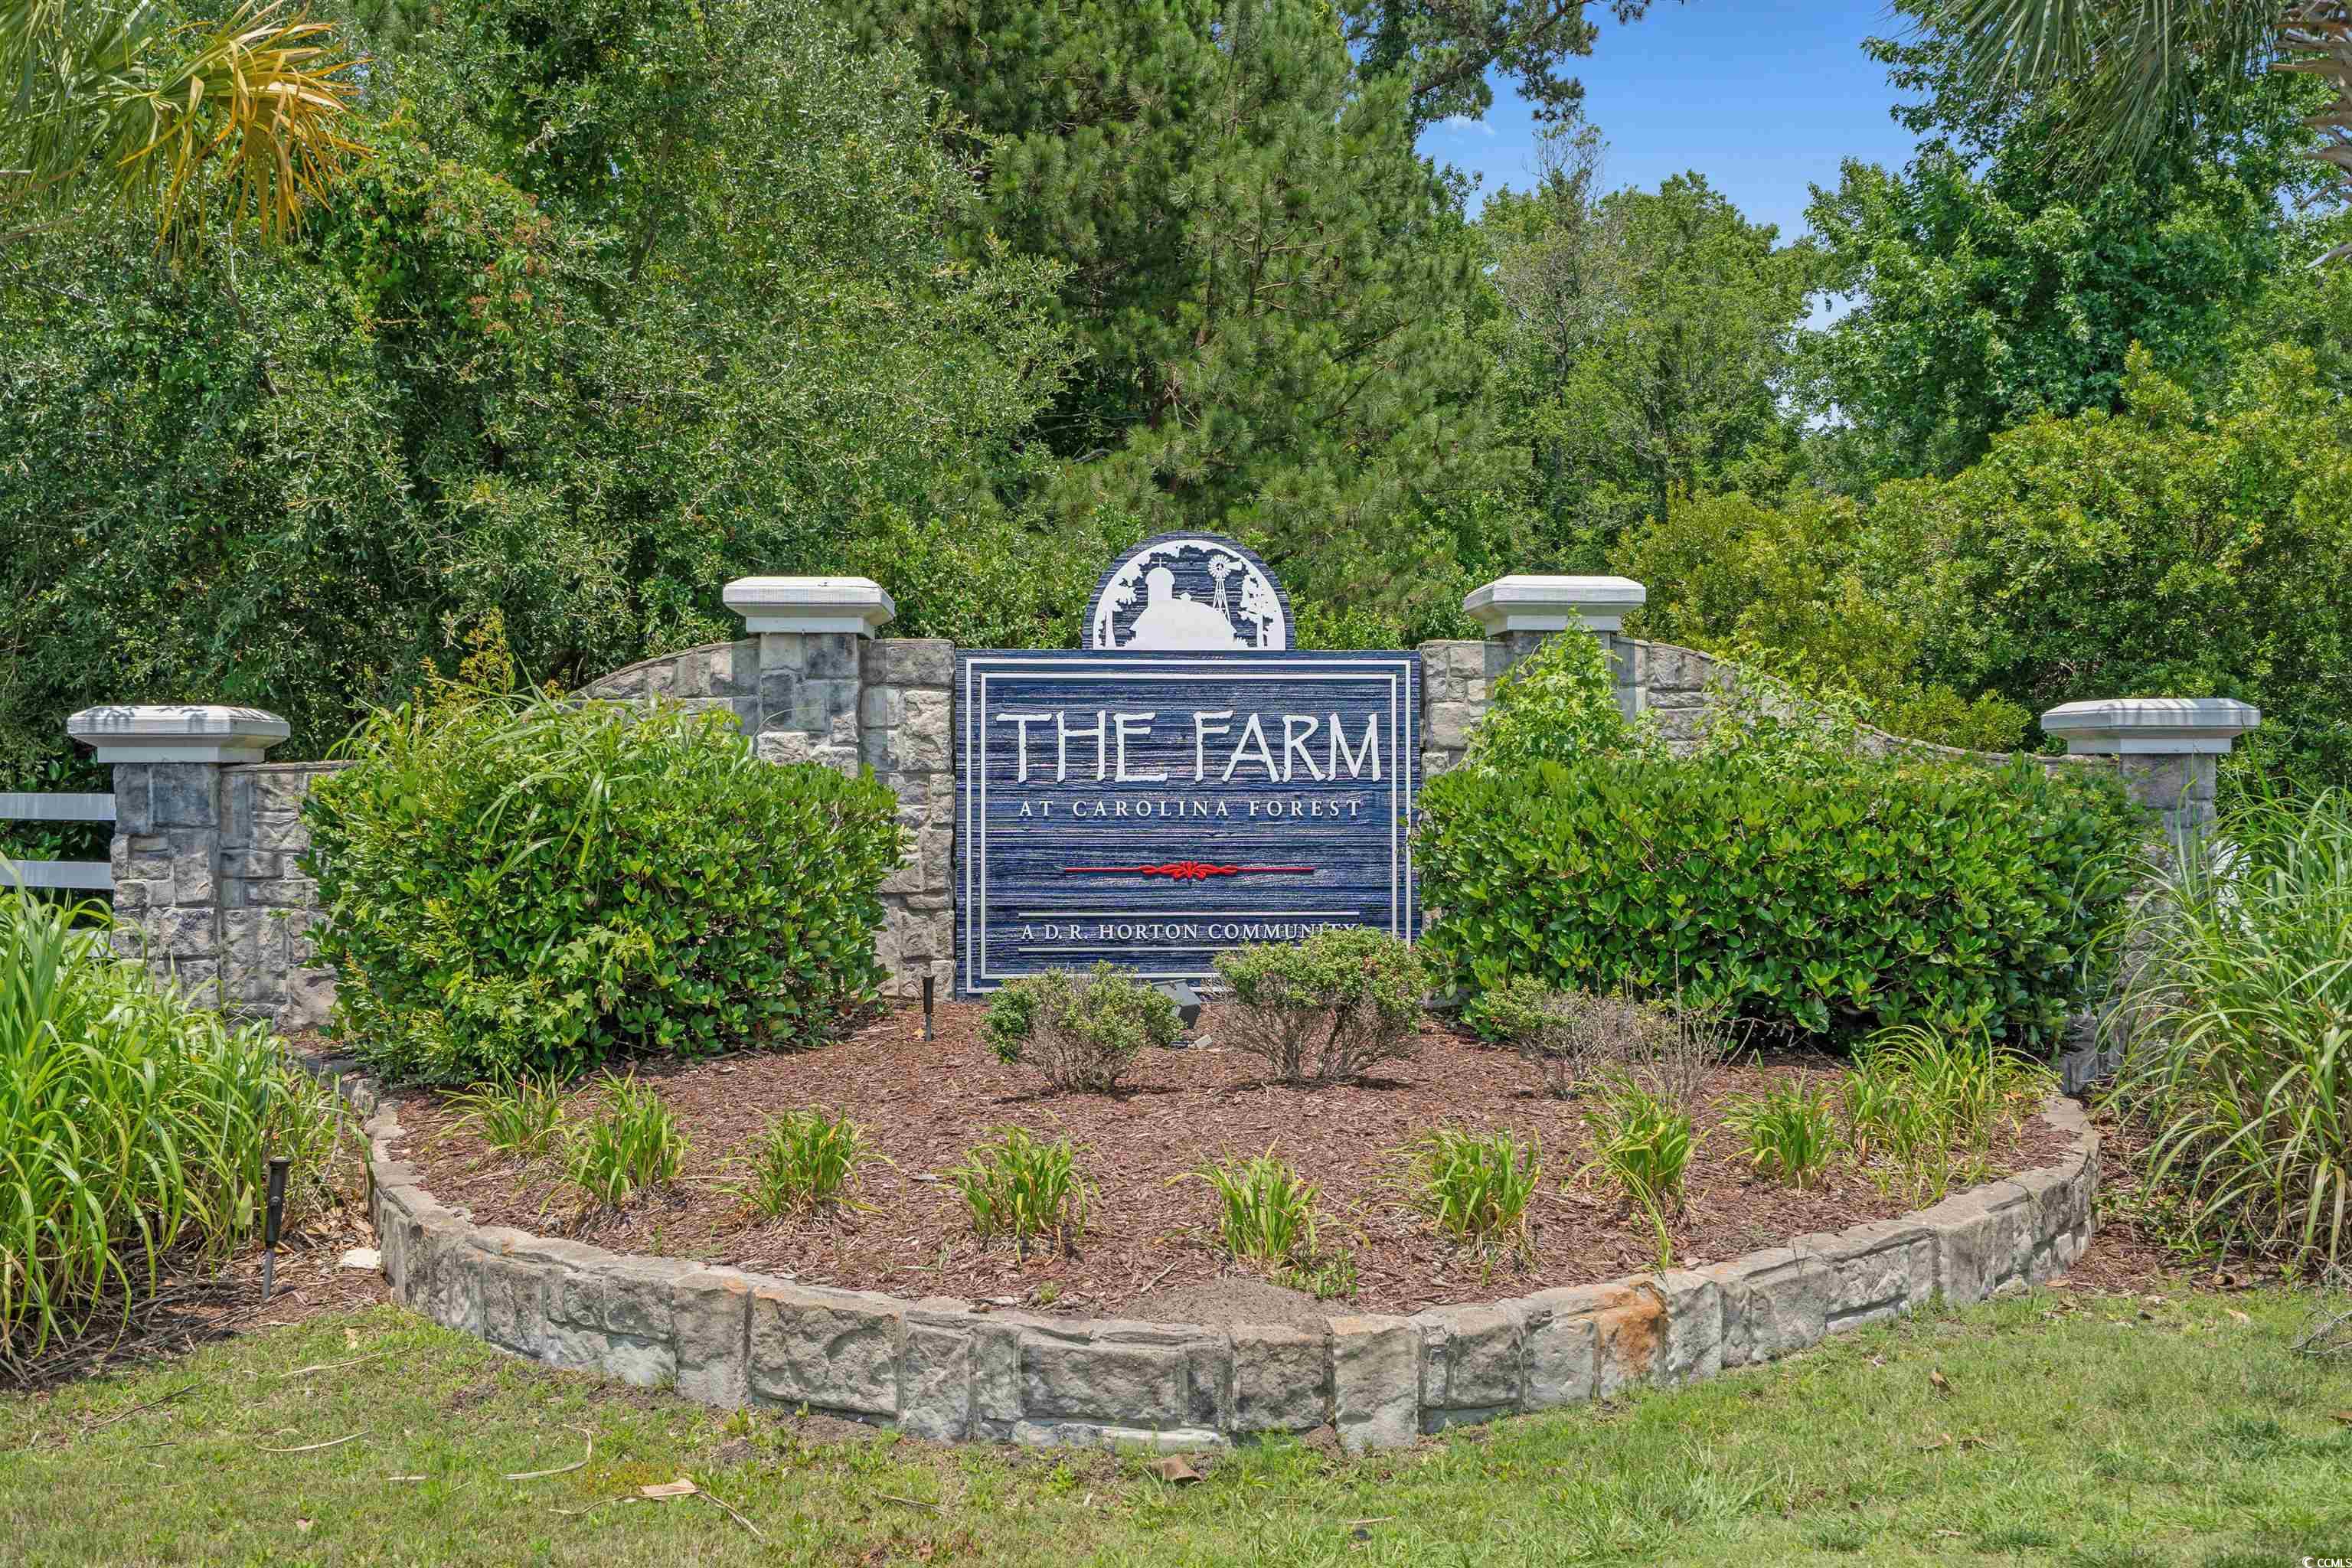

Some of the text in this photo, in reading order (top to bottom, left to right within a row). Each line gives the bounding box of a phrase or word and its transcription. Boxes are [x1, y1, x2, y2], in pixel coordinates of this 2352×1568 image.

[996, 710, 1381, 782] THE FARM
[1018, 800, 1362, 817] AT CAROLINA FOREST
[1021, 923, 1034, 939] A
[1098, 923, 1199, 939] HORTON
